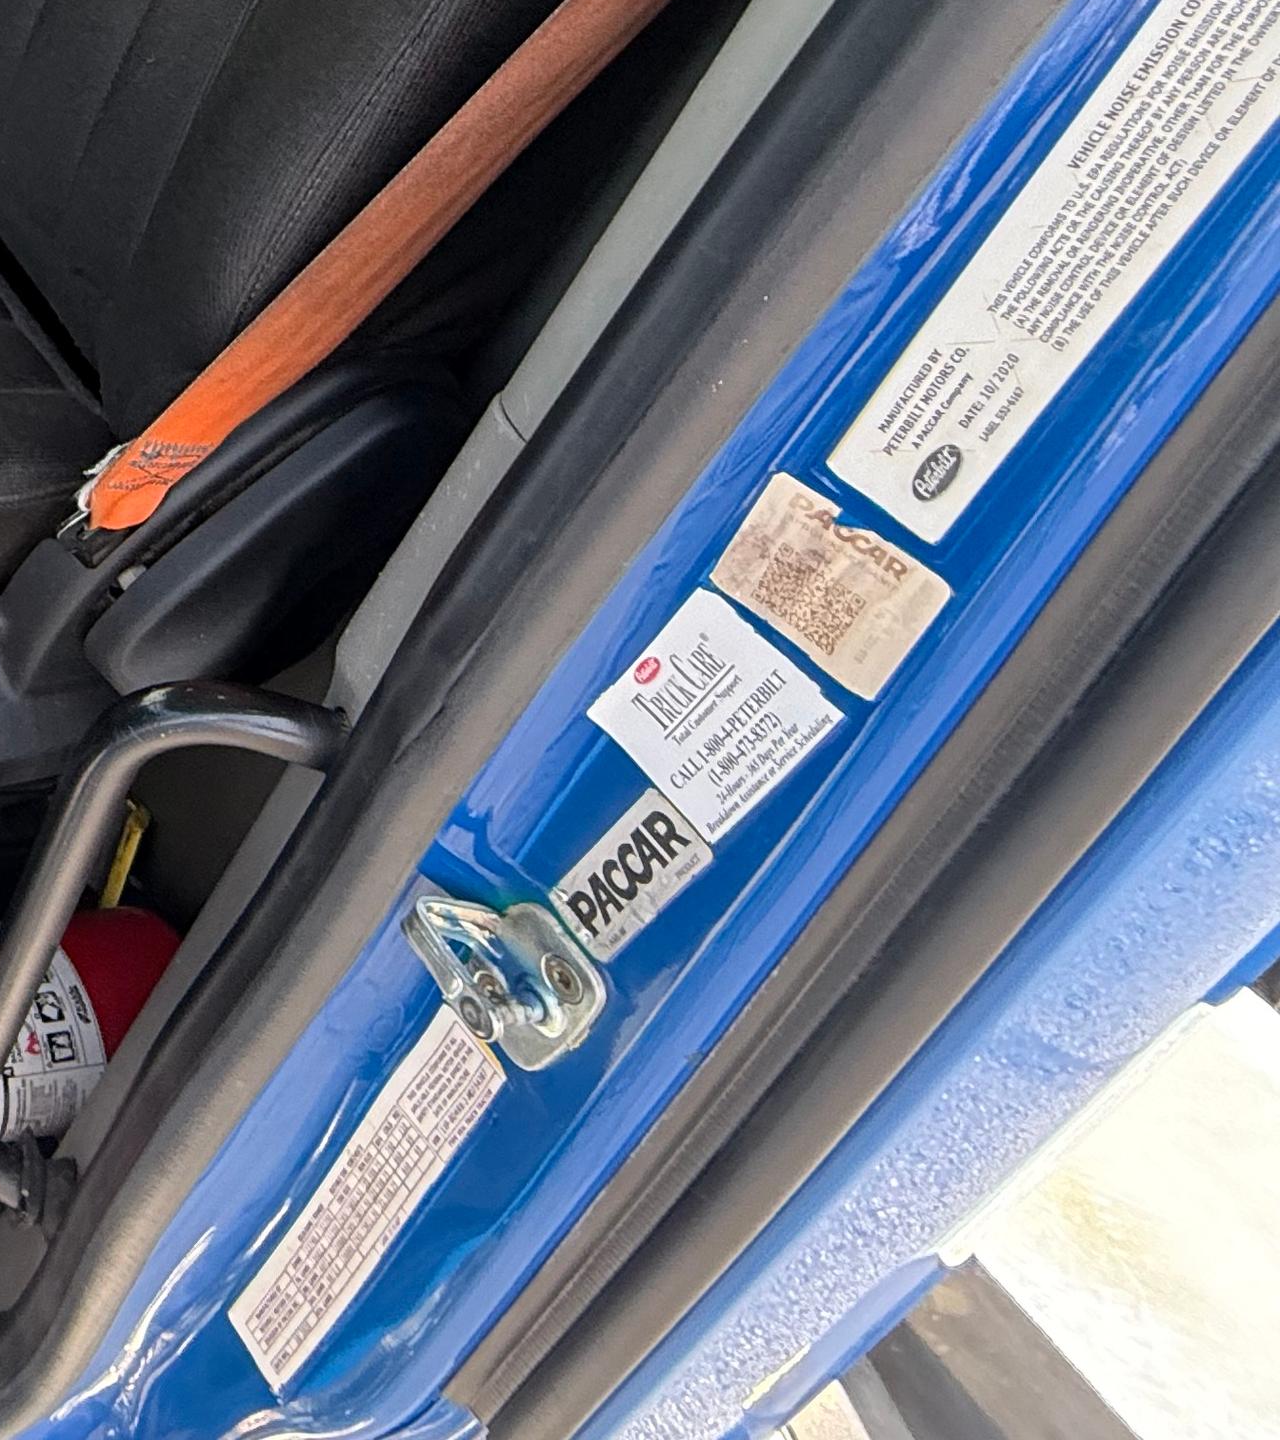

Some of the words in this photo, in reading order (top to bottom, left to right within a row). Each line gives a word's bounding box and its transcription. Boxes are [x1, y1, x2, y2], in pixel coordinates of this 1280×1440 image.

[987, 292, 1008, 313] THIS
[1001, 258, 1033, 293] VEHICLE
[1027, 211, 1067, 259] CONFORMS
[1061, 198, 1078, 212] TO
[1071, 181, 1092, 200] U.S.
[1099, 99, 1150, 162] REGULATIONS
[1145, 79, 1167, 100] FOR
[1160, 47, 1189, 79] NOISE
[1184, 0, 1227, 49] EMISSION
[1067, 119, 1112, 169] VEHICLE
[1103, 80, 1140, 121] NOISE
[1132, 18, 1187, 82] EMISSION
[1000, 302, 1019, 321] THE
[1013, 255, 1054, 305] FOLLOWING
[1048, 232, 1071, 257] ACTS
[1065, 218, 1082, 234] OR
[1075, 199, 1096, 219] THE
[1089, 160, 1126, 201] CAUSING
[1119, 119, 1155, 160] THEREOF
[1150, 105, 1166, 120] BY
[1161, 84, 1182, 107] ANY
[1175, 47, 1211, 87] PERSON
[1205, 25, 1227, 48] ARE
[1012, 312, 1030, 330] (A)
[1023, 295, 1042, 314] THE
[1036, 259, 1071, 298] REMOVAL
[1065, 244, 1081, 259] OR
[1076, 193, 1120, 245] RENDERING
[1160, 101, 1191, 133] OTHER
[1184, 73, 1212, 100] THAN
[1204, 53, 1227, 75] FOR
[1220, 31, 1244, 52] THE
[1026, 317, 1043, 336] ANY
[1039, 291, 1064, 319] NOISE
[1059, 253, 1094, 292] CONTROL
[1088, 219, 1119, 253] DEVICE
[1113, 205, 1131, 221] OR
[1124, 164, 1161, 206] ELEMENT
[1154, 150, 1170, 166] OF
[1165, 114, 1200, 152] DESIGN
[1193, 80, 1226, 116] LISTED
[1219, 66, 1237, 81] IN
[1229, 46, 1252, 66] THE
[1050, 334, 1069, 352] (B)
[1062, 318, 1081, 336] THE
[1075, 300, 1095, 320] USE
[1088, 287, 1103, 302] OF
[1099, 265, 1122, 288] THIS
[1115, 229, 1150, 267] VEHICLE
[1144, 201, 1173, 231] AFTER
[1166, 175, 1193, 203] SUCH
[1186, 140, 1220, 177] DEVICE
[1213, 125, 1232, 142] OR
[1225, 81, 1266, 126] ELEMENT
[1260, 65, 1277, 83] OF
[1037, 290, 1083, 344] COMPLIANCE
[1077, 267, 1101, 292] WITH
[1095, 248, 1115, 268] THE
[1109, 220, 1137, 251] NOISE
[1131, 181, 1169, 223] CONTROL
[877, 362, 932, 433] MANUFACTURED
[927, 347, 943, 364] BY
[882, 403, 925, 456] PETERBILT
[919, 361, 956, 406] MOTORS
[949, 346, 970, 364] CO.
[910, 440, 921, 449] A
[916, 408, 945, 442] PACCAR
[939, 371, 974, 410] Company
[910, 442, 957, 498] Peterbilt
[671, 725, 692, 746] Total
[686, 698, 719, 730] Customer
[714, 673, 743, 703] Support
[707, 711, 783, 787] (1-800-473-8372)
[566, 810, 689, 936] PACCAR
